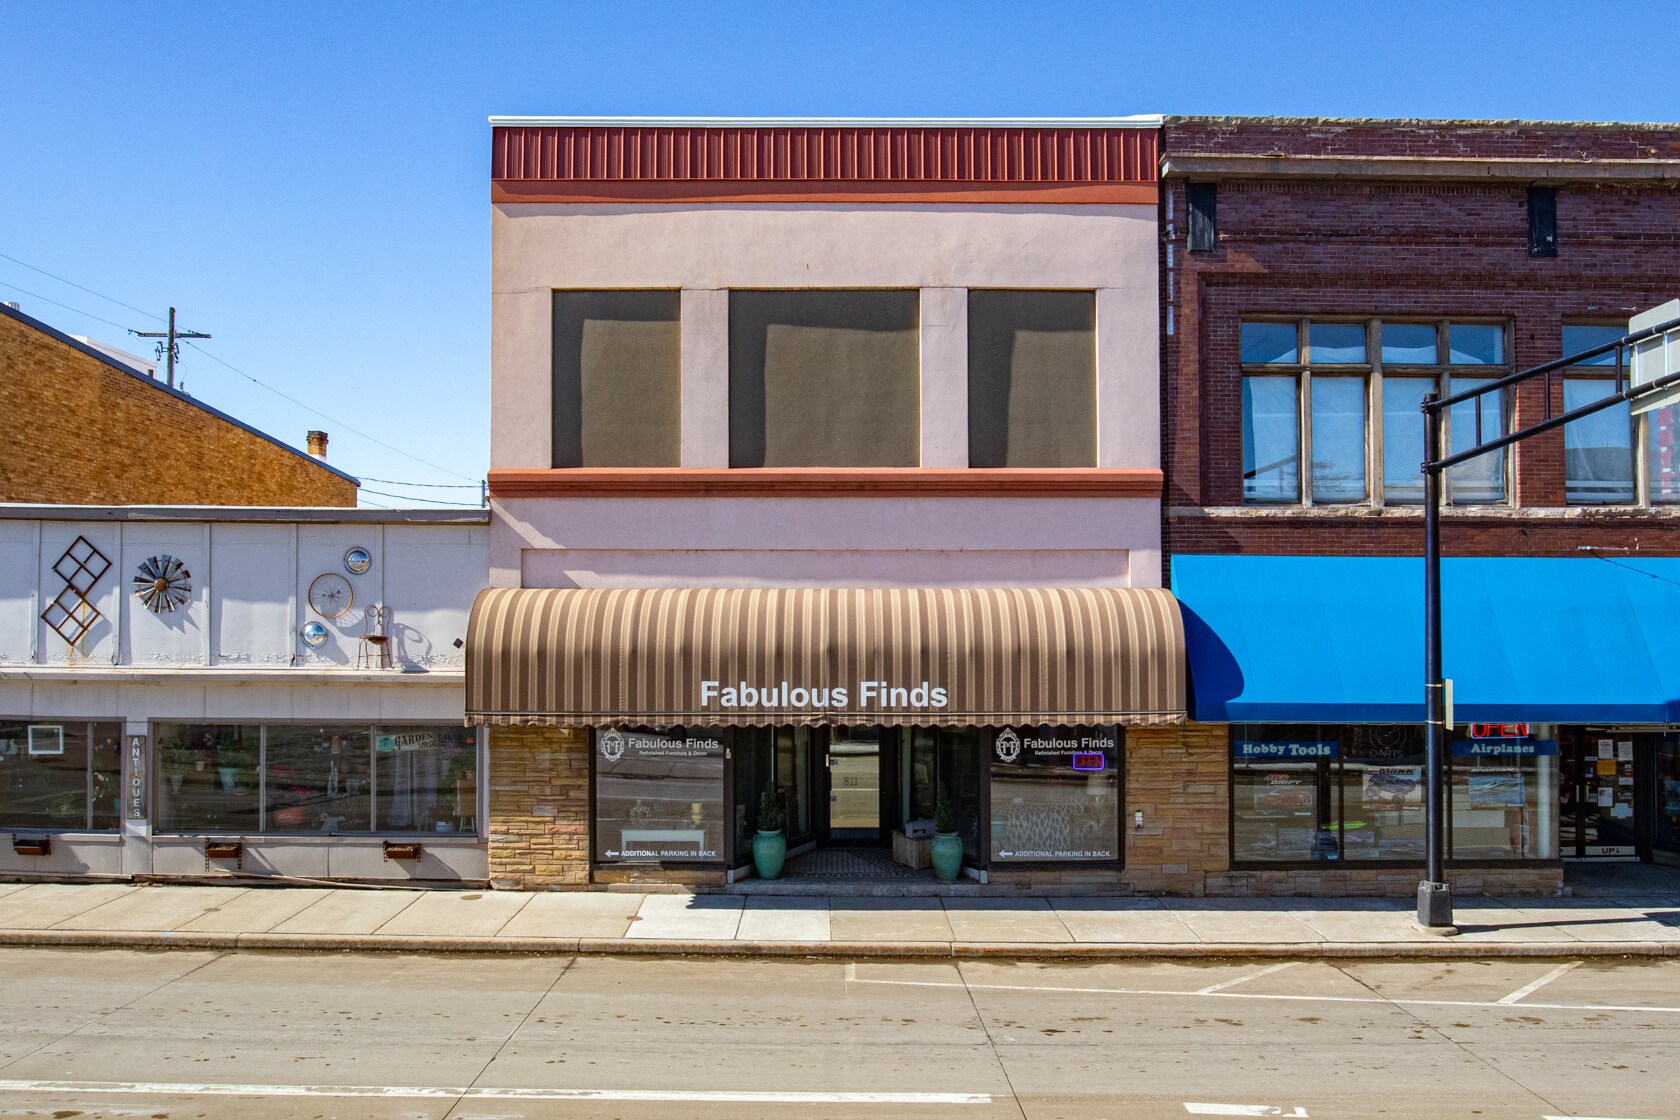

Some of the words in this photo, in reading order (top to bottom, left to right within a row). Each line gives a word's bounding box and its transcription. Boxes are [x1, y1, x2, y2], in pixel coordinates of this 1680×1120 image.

[701, 680, 849, 707] Fabulous
[860, 680, 948, 707] Finds
[394, 733, 433, 750] GARDEN
[417, 740, 435, 749] SHED
[628, 738, 682, 749] Fabulous
[686, 738, 719, 749] Finds
[1023, 738, 1078, 749] Fabulous
[1081, 738, 1114, 748] Finds
[1242, 743, 1286, 756] Hobby
[1288, 743, 1331, 756] Tools
[1369, 749, 1404, 758] DARTS
[1471, 743, 1535, 755] Airplanes
[843, 776, 859, 787] 811
